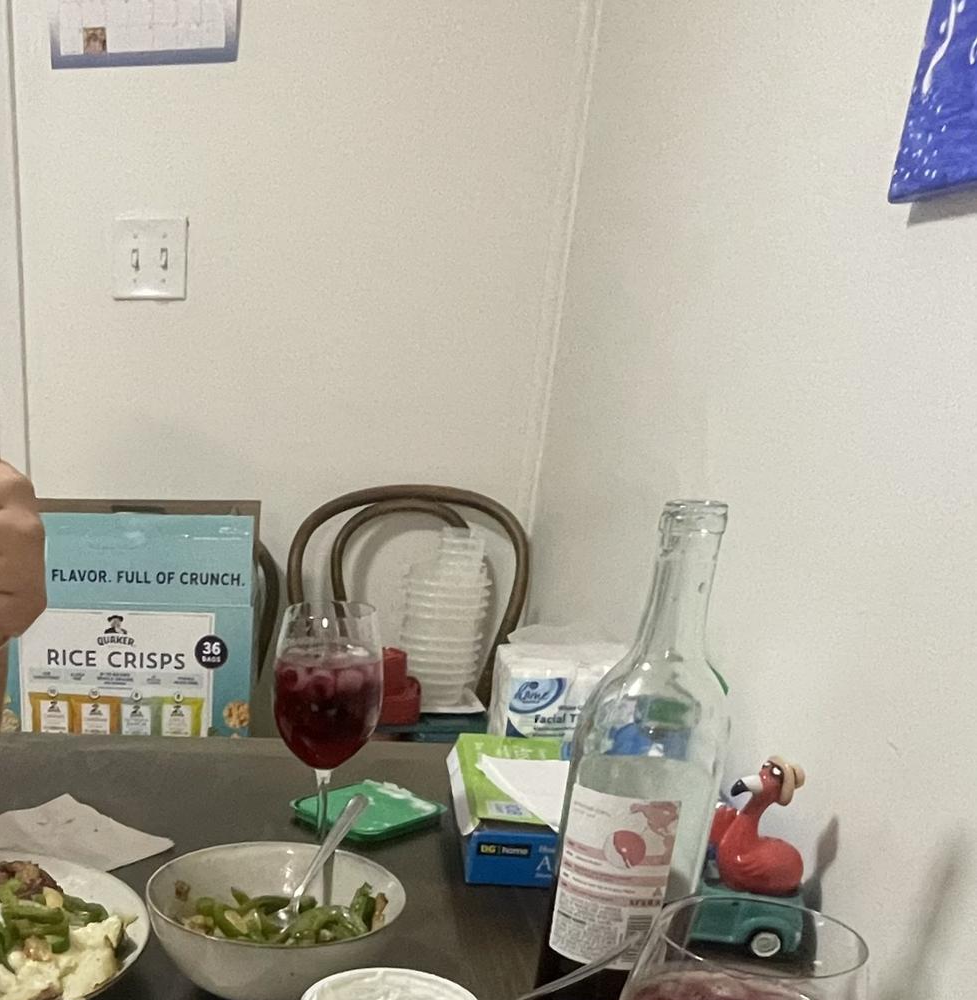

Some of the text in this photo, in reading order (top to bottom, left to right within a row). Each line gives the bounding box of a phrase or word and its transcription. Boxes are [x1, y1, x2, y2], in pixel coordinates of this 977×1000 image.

[50, 568, 246, 588] FLAVOR. FULL OF CRUNCH.
[96, 635, 136, 647] QUAKER
[201, 641, 222, 656] 36
[46, 648, 186, 671] RICE CRISPS
[200, 655, 222, 664] BAGS
[534, 713, 566, 724] Facial
[480, 844, 496, 854] DG
[501, 846, 529, 856] home
